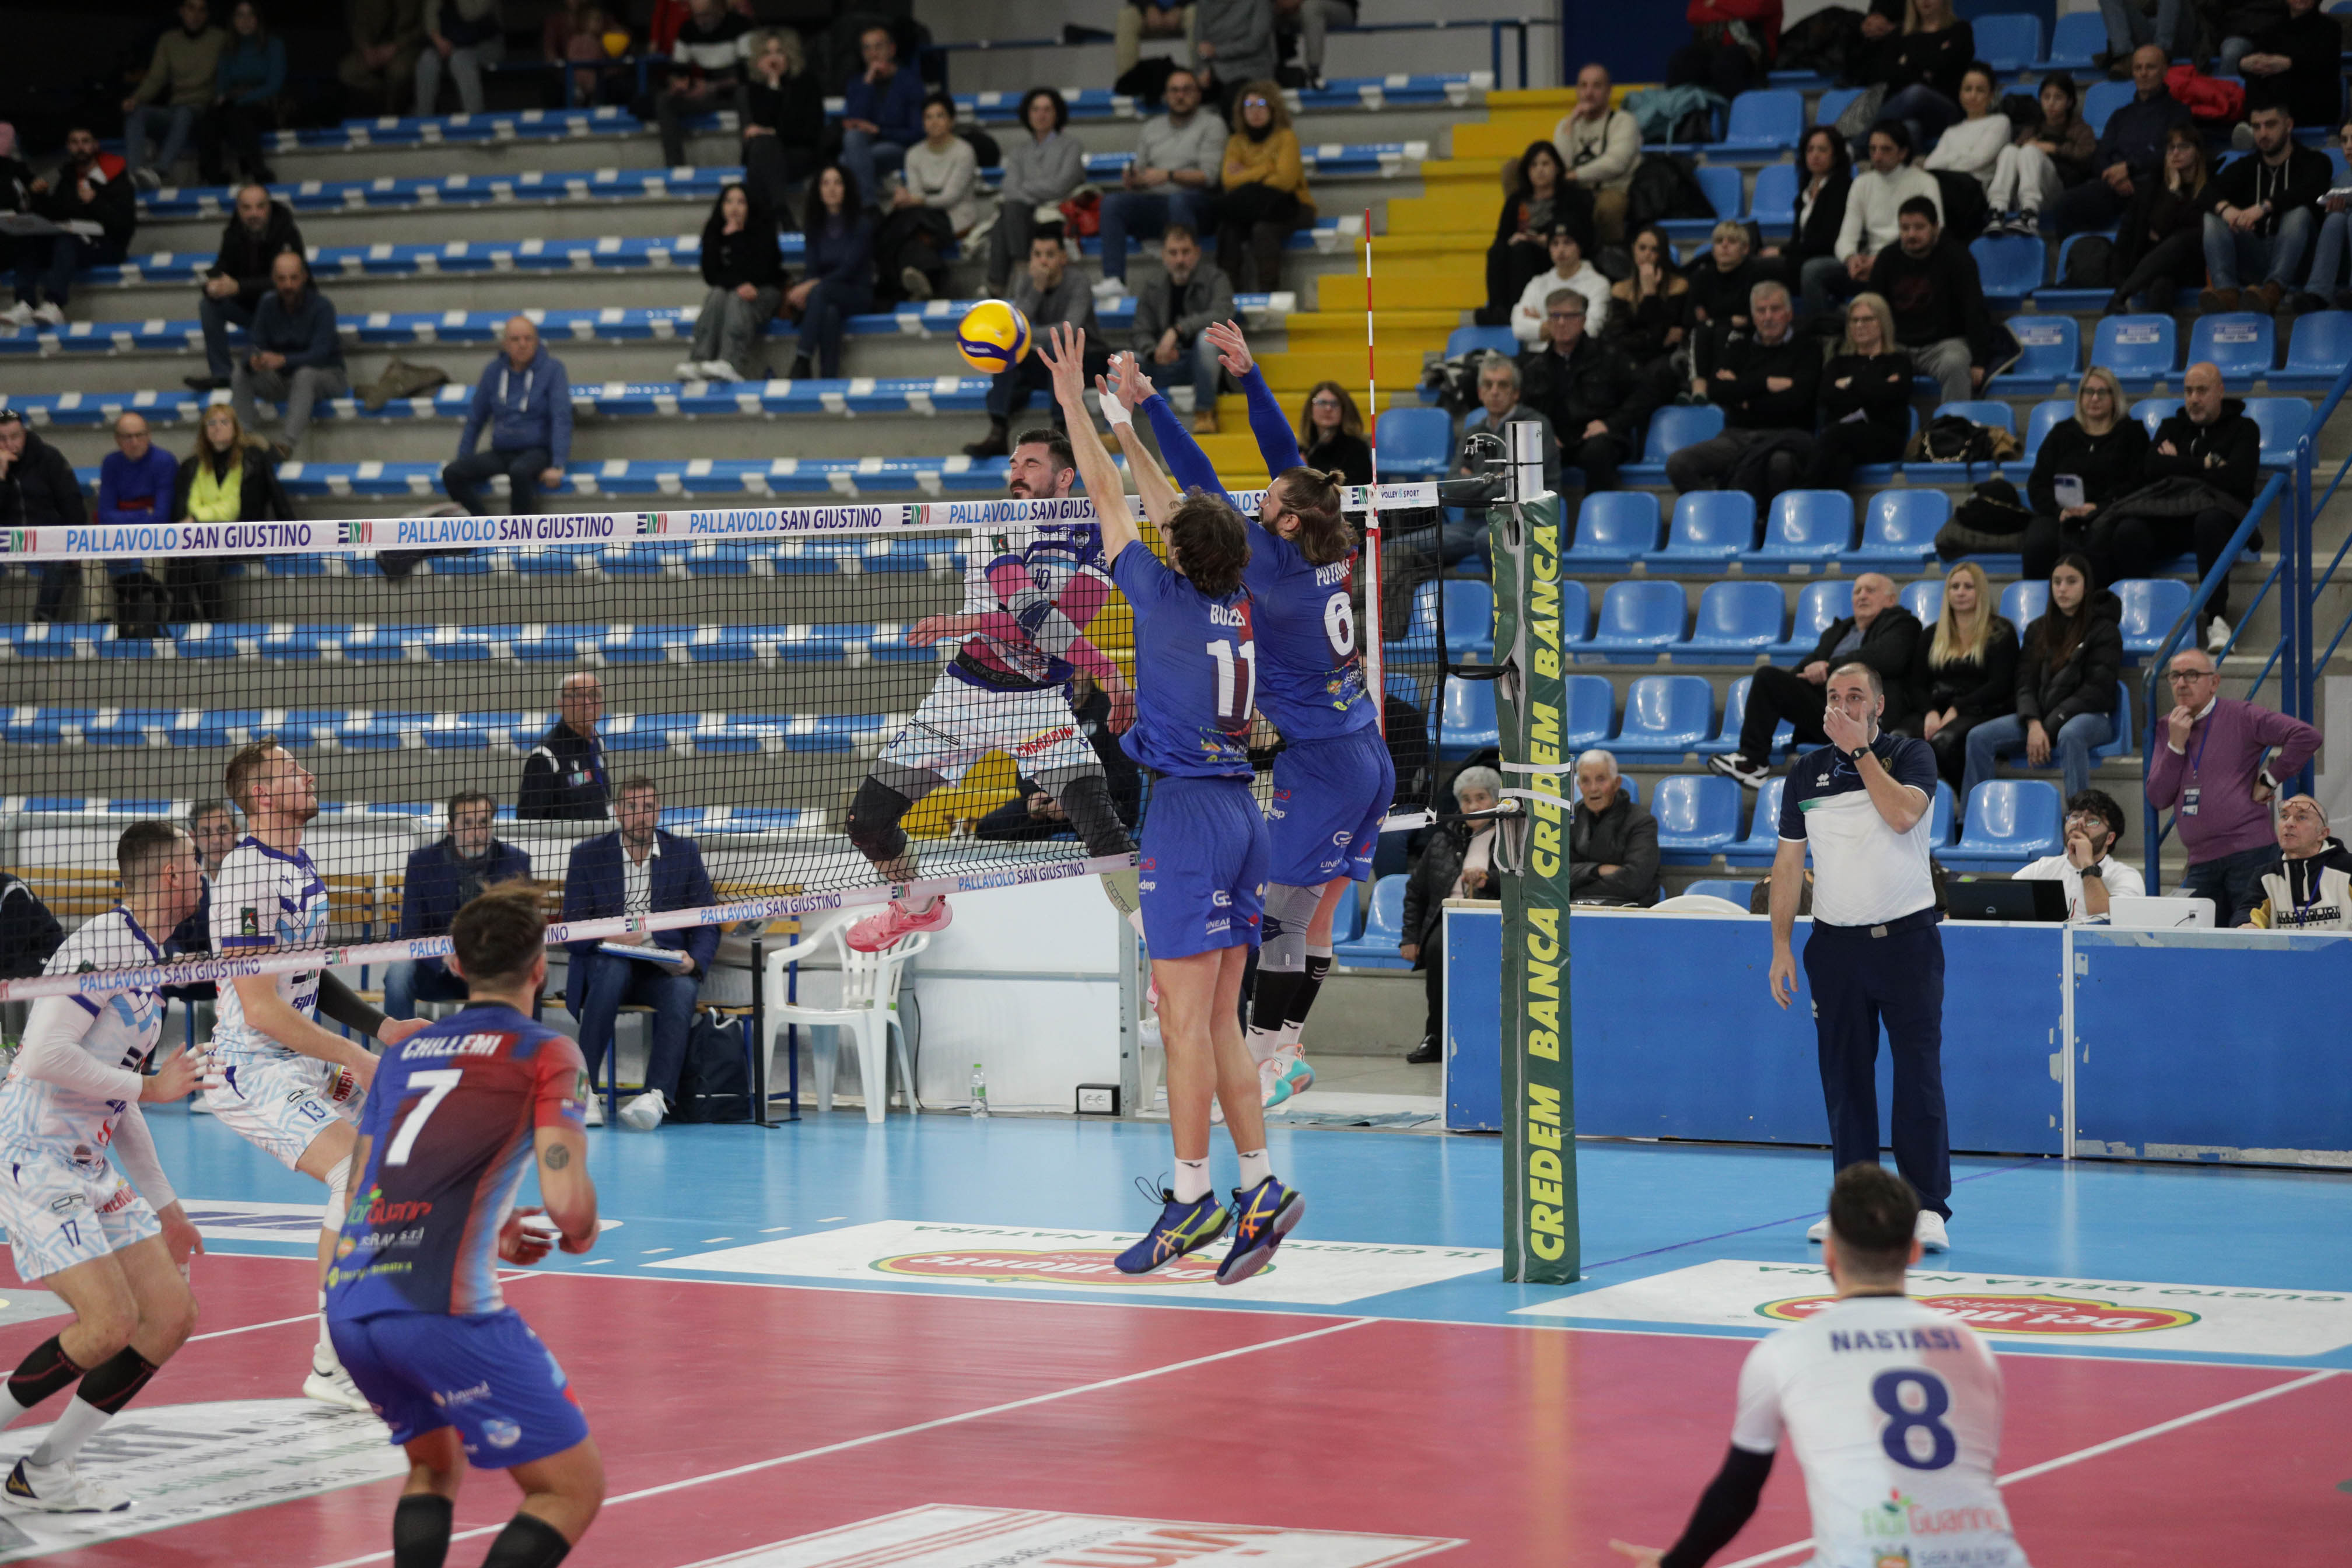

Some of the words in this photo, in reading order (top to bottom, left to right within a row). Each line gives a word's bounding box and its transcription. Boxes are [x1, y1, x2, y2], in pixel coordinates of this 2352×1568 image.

[1381, 490, 1398, 498] VOLLEY
[1404, 489, 1419, 498] SPORT
[690, 511, 777, 534] PALLAVOLO
[779, 510, 811, 531] SAN
[813, 507, 883, 530] GIUSTINO
[949, 502, 1028, 524] PALLAVOLO
[1029, 501, 1058, 521] SAN
[1060, 499, 1099, 519] GIUST
[66, 527, 177, 552] PALLAVOLO
[182, 526, 220, 550] SAN
[226, 523, 313, 548] GIUSTINO
[398, 519, 496, 544] PALLAVOLO
[499, 519, 534, 541] SAN
[536, 516, 614, 540] GIUSTINO
[1034, 568, 1050, 590] 10
[1531, 524, 1560, 681] BANCA
[1324, 591, 1354, 656] 6
[1206, 639, 1255, 720] 11
[1016, 725, 1075, 757] CHERUBIN
[1530, 701, 1561, 878] CREDEM
[958, 872, 1015, 891] PALLAVOLO
[1017, 868, 1037, 884] SAN
[1039, 862, 1086, 882] GIUSTINO
[700, 903, 764, 925] PALLAVOLO
[765, 895, 788, 916] SAN
[790, 893, 842, 914] GIUSTINO
[410, 938, 454, 958] PALLAV
[79, 968, 162, 992] PALLAVOLO
[164, 965, 192, 984] SAN
[196, 958, 261, 981] GIUSTINO
[1527, 907, 1560, 1063] BANCA
[401, 1033, 503, 1061] CHILLEMI
[299, 1100, 327, 1123] 13
[385, 1068, 463, 1166] 7
[1528, 1082, 1566, 1261] CREDEM
[60, 1218, 81, 1248] 17
[910, 1225, 1097, 1240] NATURA
[1985, 1278, 2147, 1293] DELLA
[2160, 1289, 2345, 1302] GUSTO
[2036, 1312, 2154, 1328] Del
[1830, 1327, 1962, 1353] NASTASI
[1871, 1367, 1958, 1471] 8
